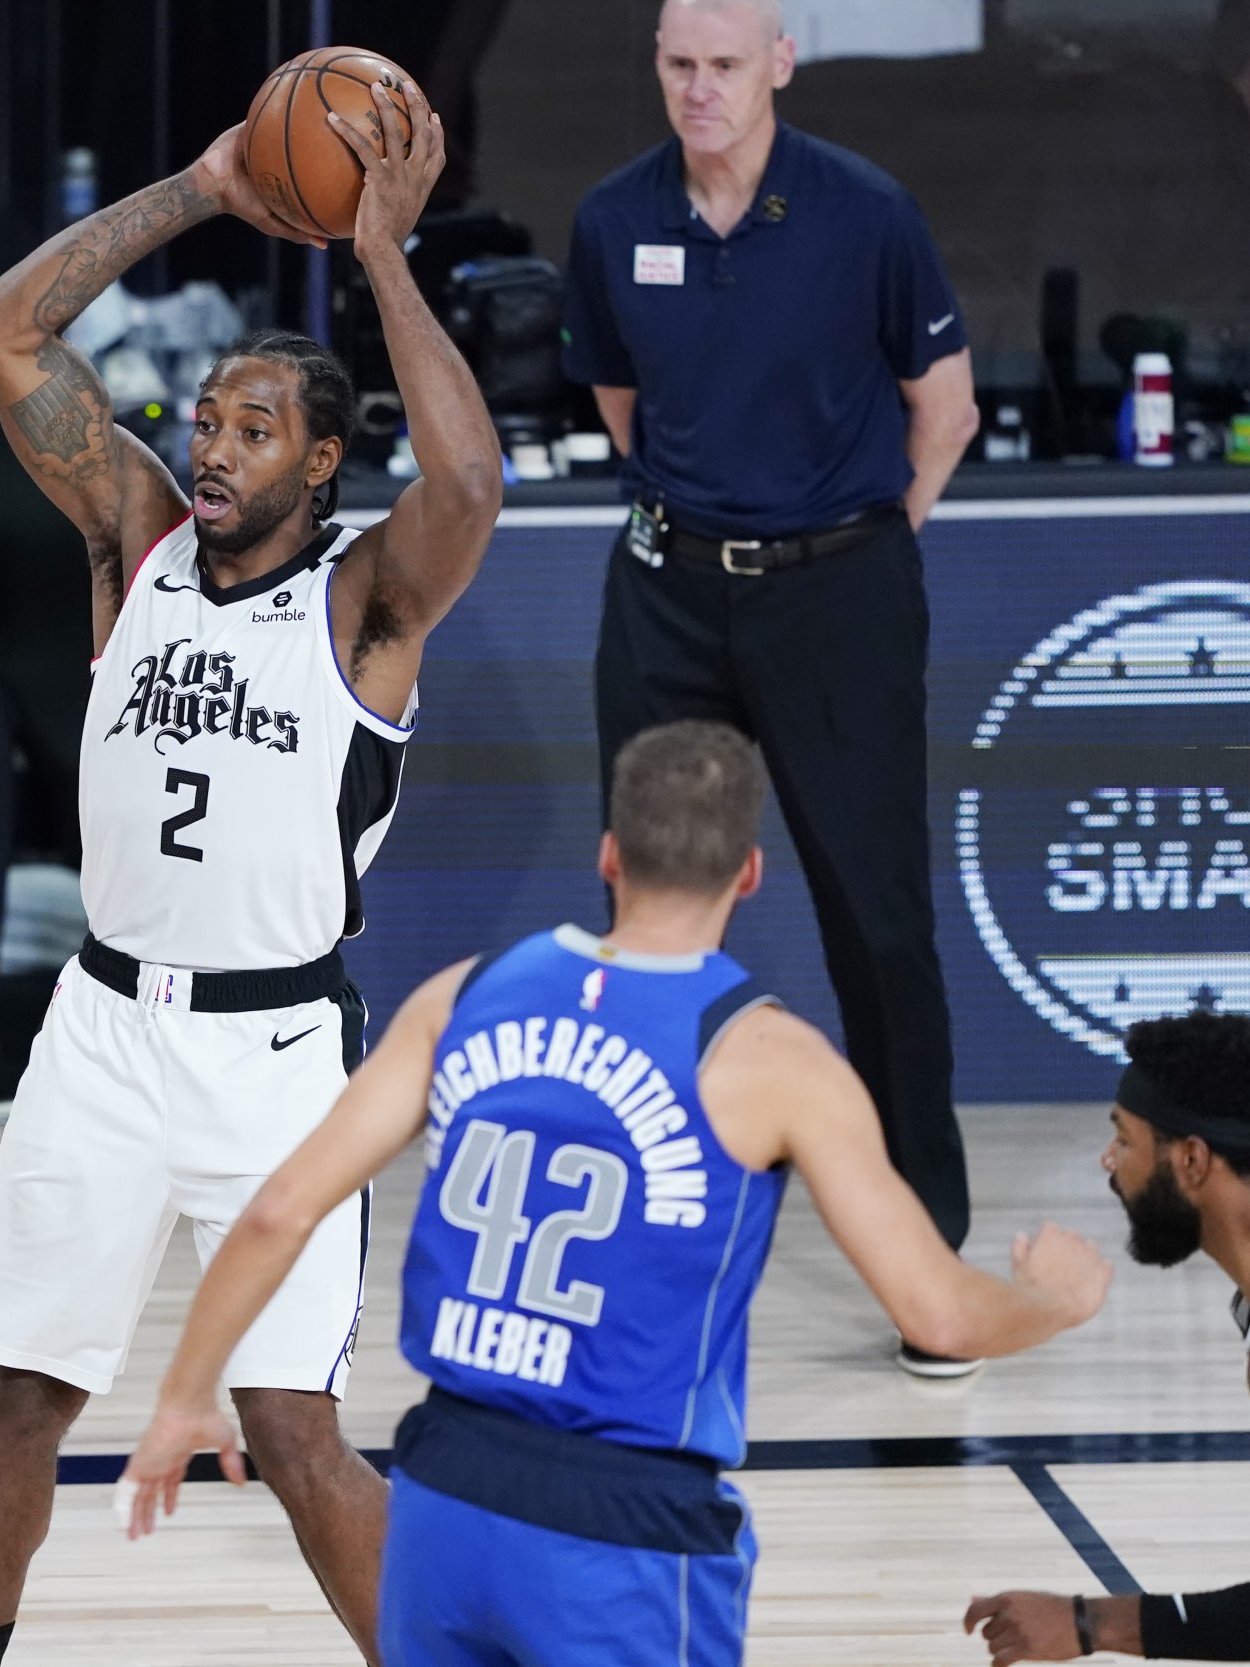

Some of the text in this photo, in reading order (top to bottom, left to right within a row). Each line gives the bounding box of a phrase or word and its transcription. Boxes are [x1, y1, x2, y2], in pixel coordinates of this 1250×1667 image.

[251, 608, 306, 623] bumble
[104, 655, 300, 755] Angeles
[155, 638, 236, 695] Los
[160, 766, 210, 863] 2
[439, 1118, 628, 1327] 42
[430, 1297, 573, 1388] KLEBER
